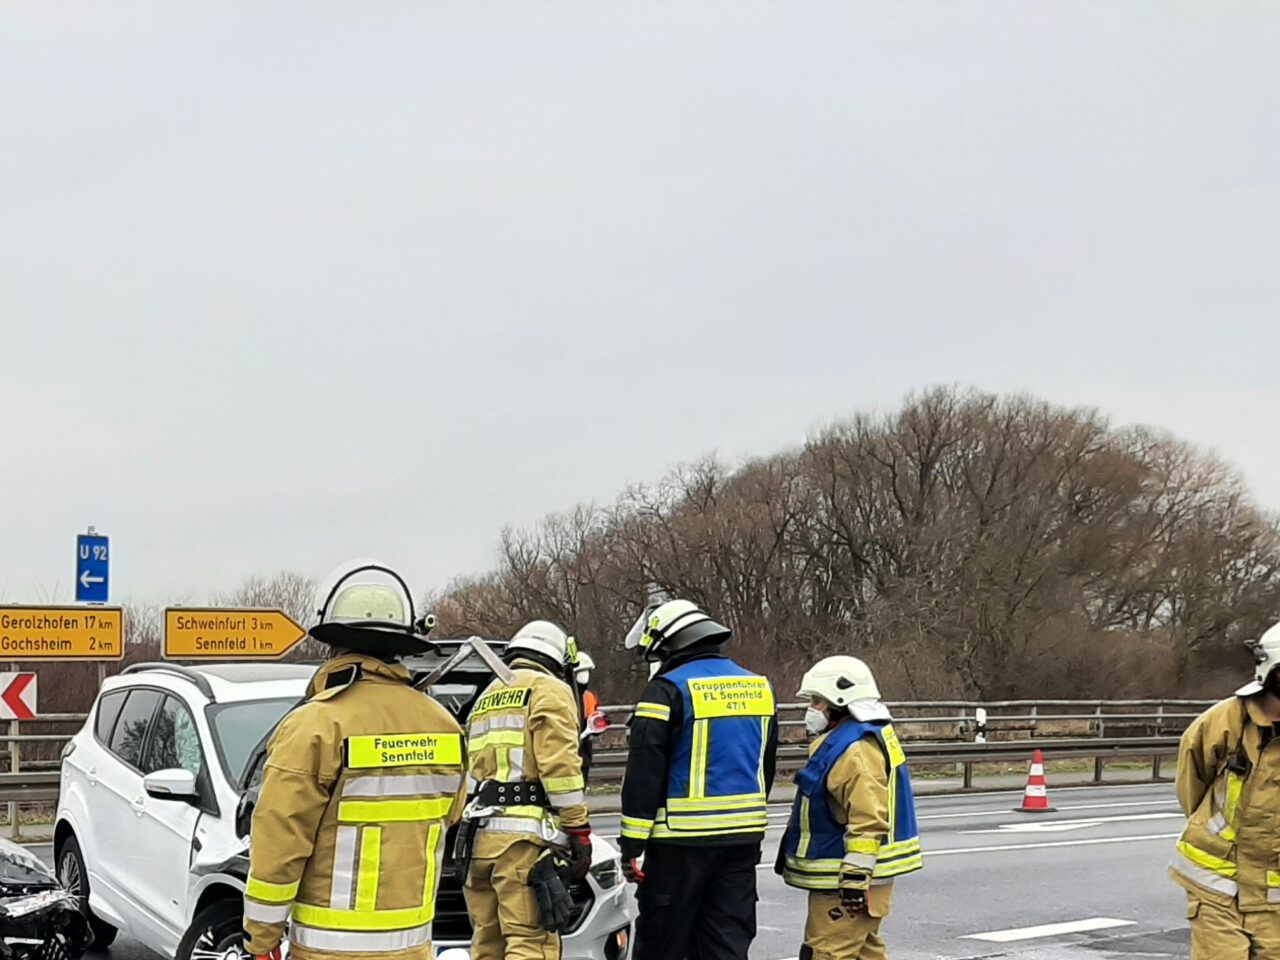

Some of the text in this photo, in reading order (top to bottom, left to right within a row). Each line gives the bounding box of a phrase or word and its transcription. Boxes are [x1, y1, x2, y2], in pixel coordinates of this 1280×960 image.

[80, 544, 108, 561] U 92
[1, 614, 112, 629] Gerolzhofen 17 km
[176, 616, 273, 630] Schweinfurt 3 km
[1, 636, 112, 650] Gochsheim 2 km
[195, 636, 273, 650] Sennfeld 1 km
[692, 680, 766, 691] Gruppenführer
[474, 689, 524, 712] UERWEHR
[703, 690, 763, 701] FL Sennfeld
[726, 701, 747, 710] 47/1
[374, 736, 438, 749] Feuerwehr
[381, 750, 435, 763] Sennfeld
